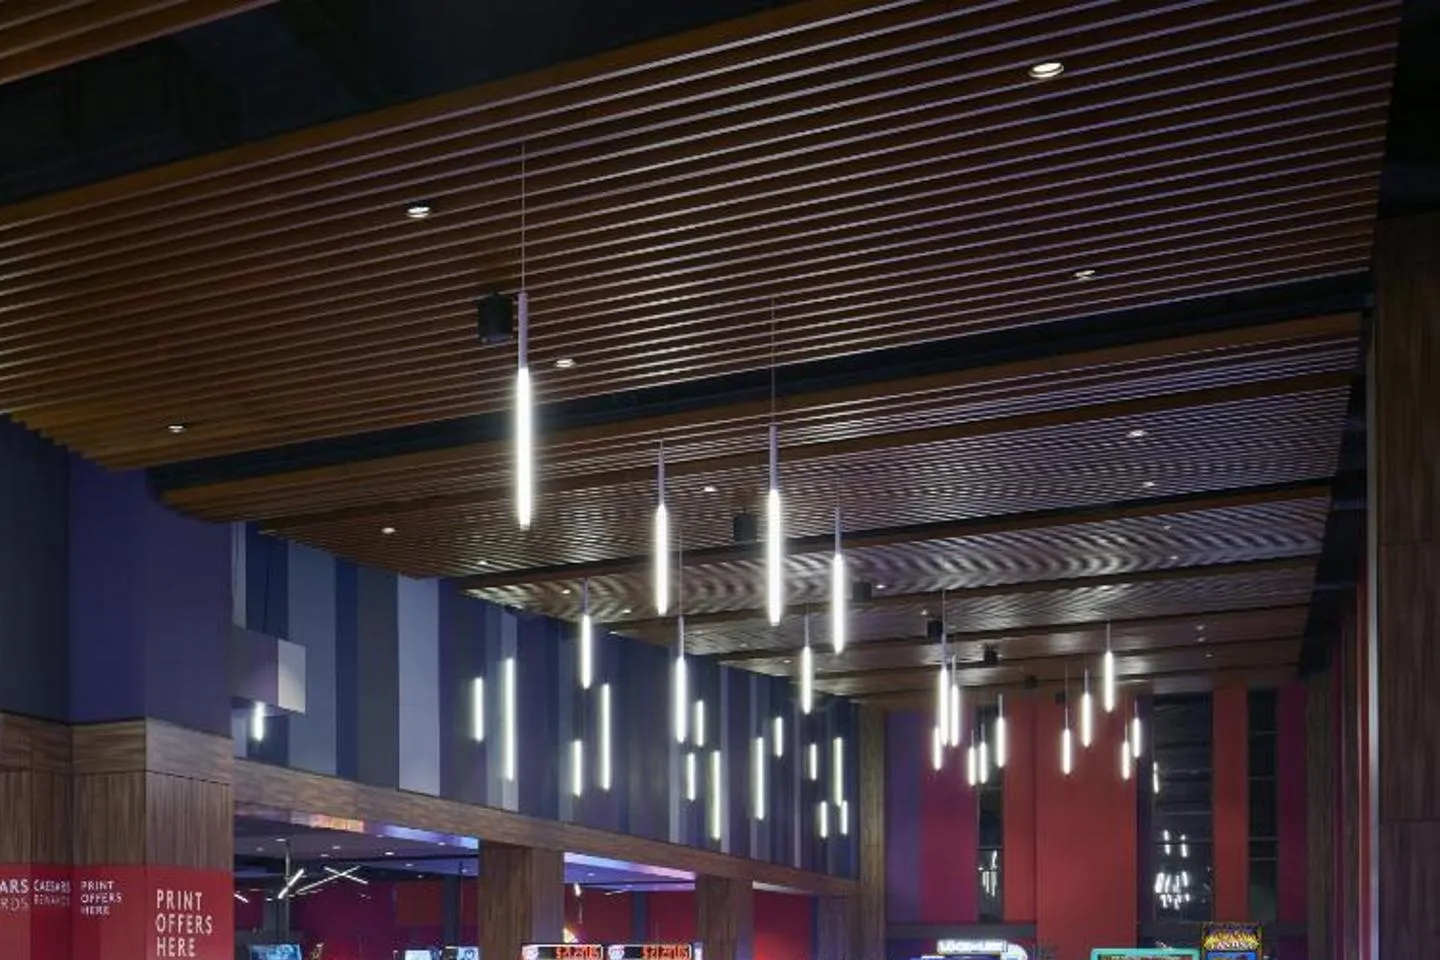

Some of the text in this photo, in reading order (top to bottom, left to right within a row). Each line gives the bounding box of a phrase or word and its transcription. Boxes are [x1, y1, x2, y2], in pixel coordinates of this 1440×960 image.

[81, 880, 115, 891] PRINT
[80, 892, 123, 904] OFFERS
[156, 888, 203, 911] PRINT
[81, 905, 111, 916] HERE
[155, 912, 213, 935] OFFERS
[156, 936, 196, 957] HERE
